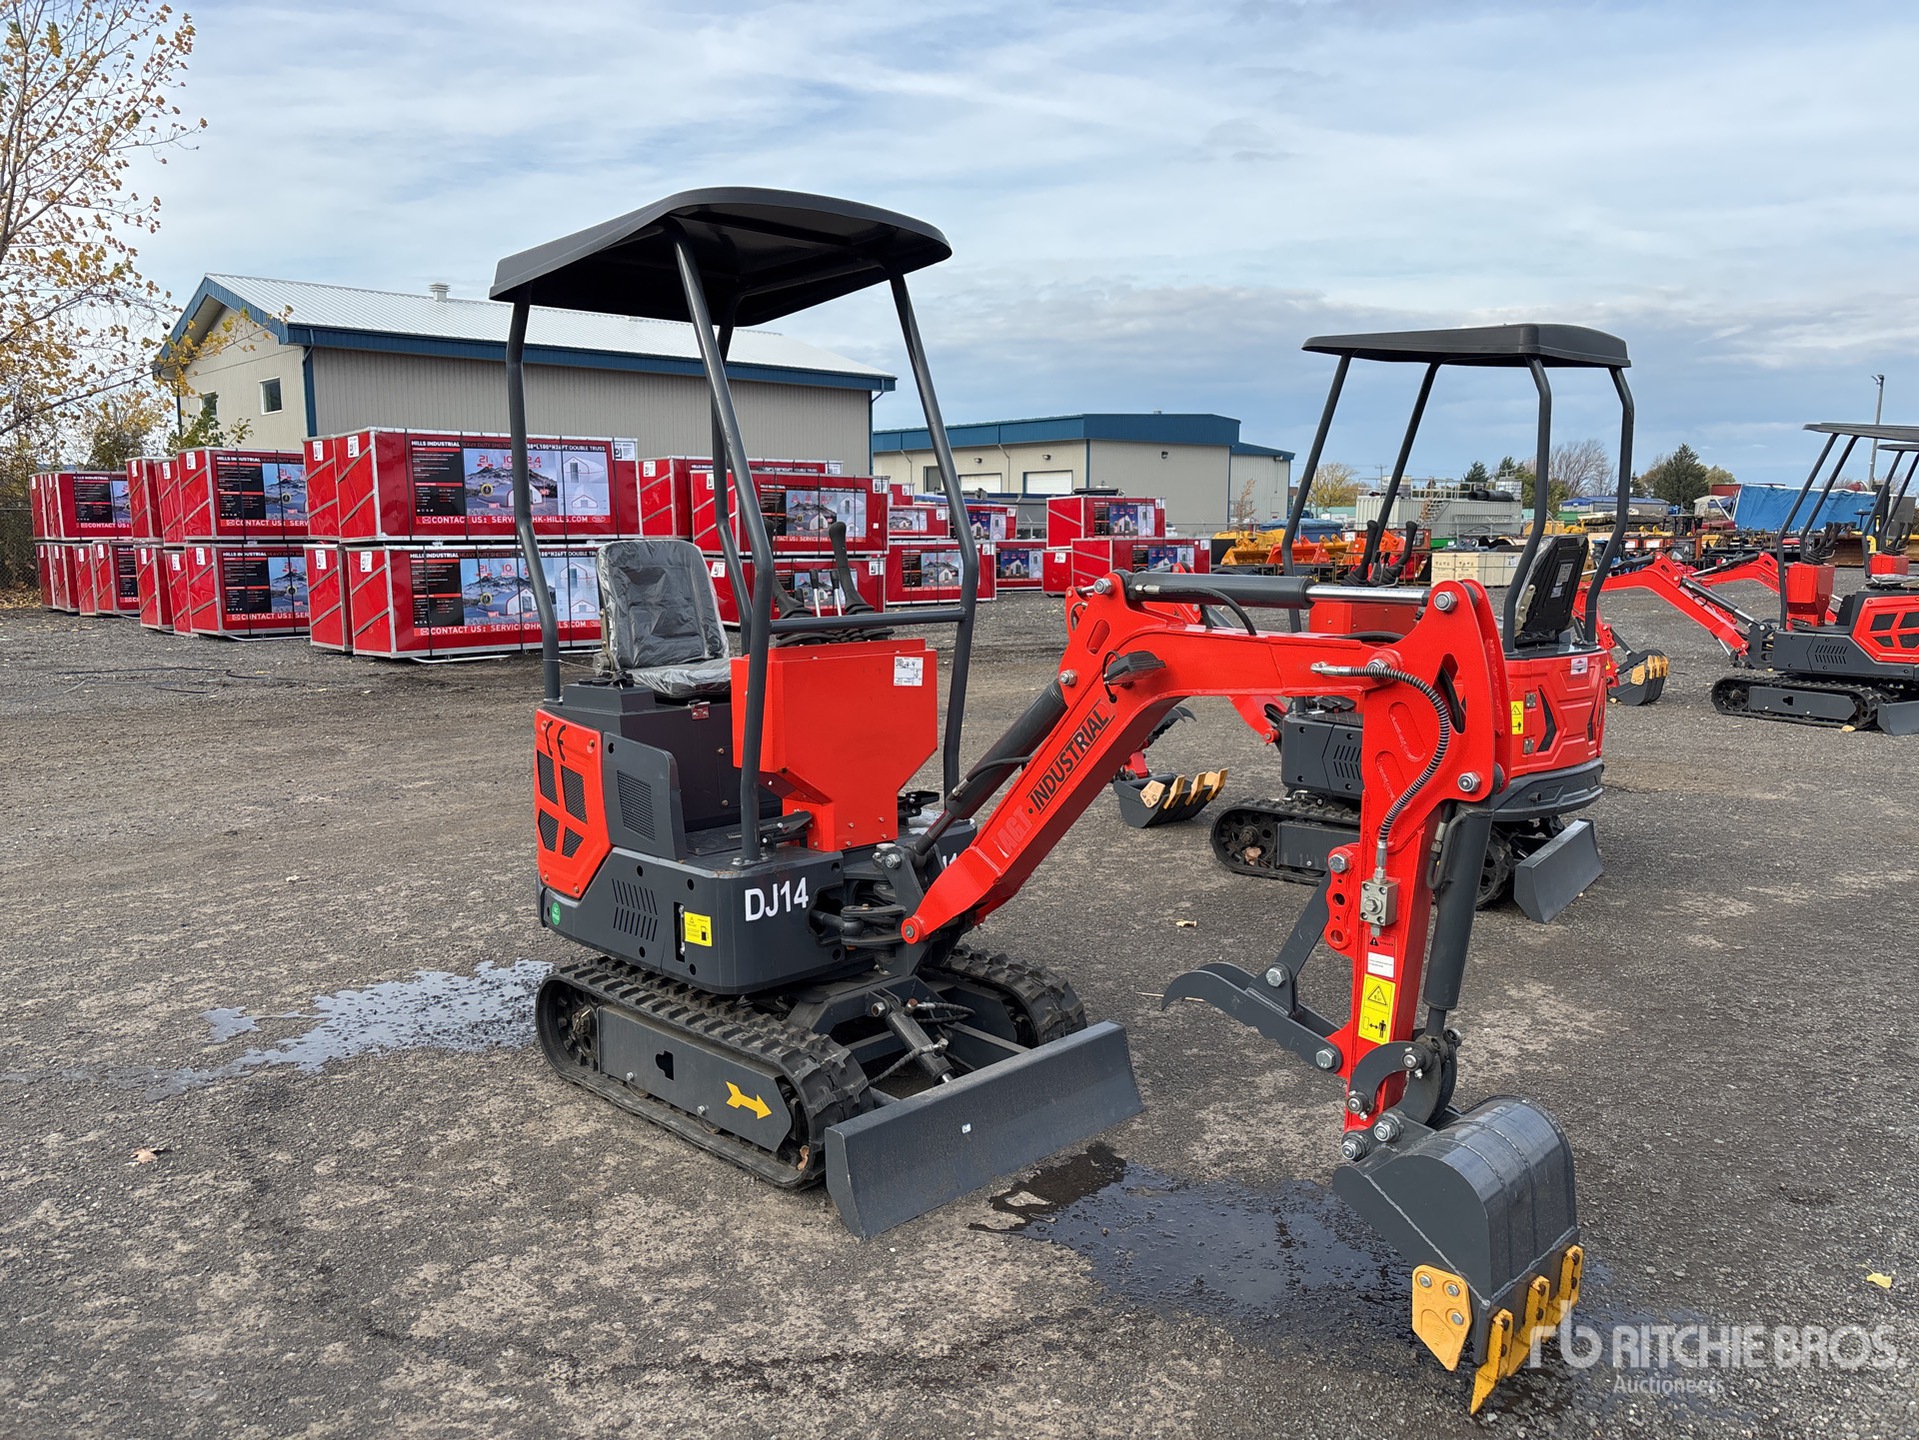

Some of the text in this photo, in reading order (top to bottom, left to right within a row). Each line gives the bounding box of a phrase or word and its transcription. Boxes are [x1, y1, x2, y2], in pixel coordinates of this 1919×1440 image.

[479, 455, 488, 463] 21
[502, 564, 512, 572] 10
[430, 626, 468, 635] CONTACT
[470, 625, 486, 633] US:
[1029, 709, 1109, 811] INDUSTRIAL
[744, 876, 809, 922] DJ14
